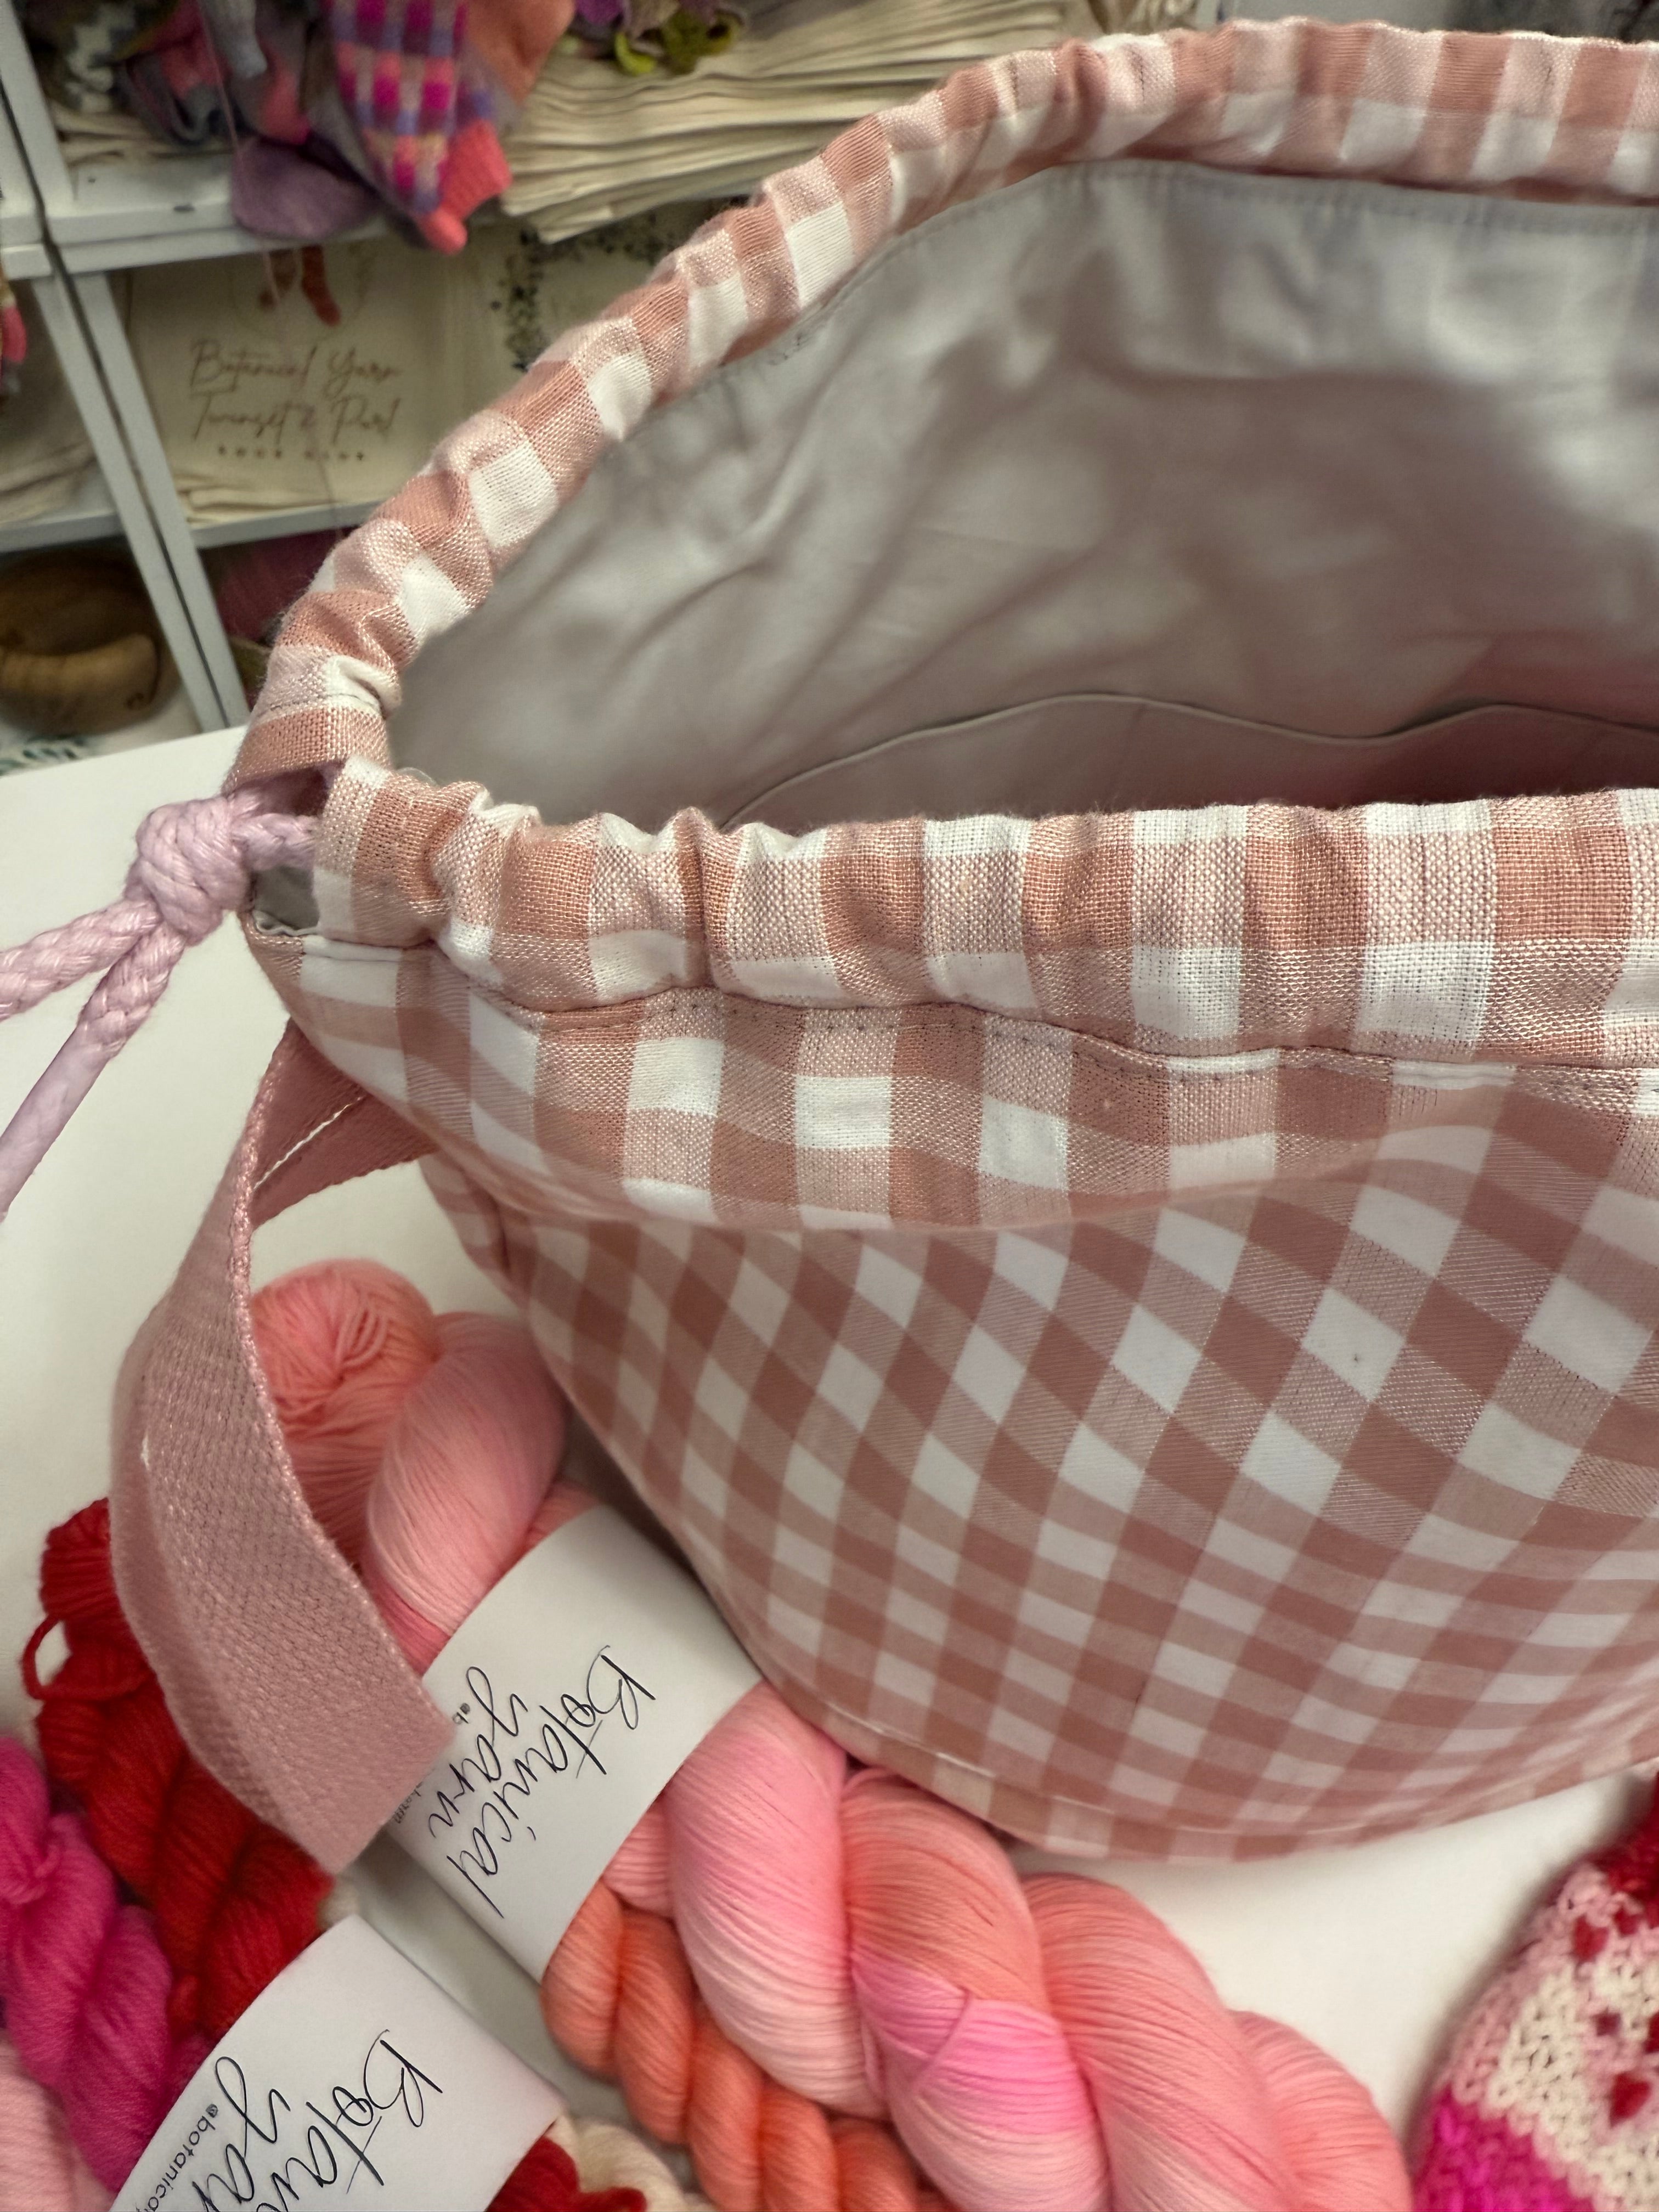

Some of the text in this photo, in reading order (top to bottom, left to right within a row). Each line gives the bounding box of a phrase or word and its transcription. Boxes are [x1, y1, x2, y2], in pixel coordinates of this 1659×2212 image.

[428, 1666, 528, 1838] yarn
[447, 1645, 656, 1918] Botanical
[136, 2103, 219, 2212] @botanica
